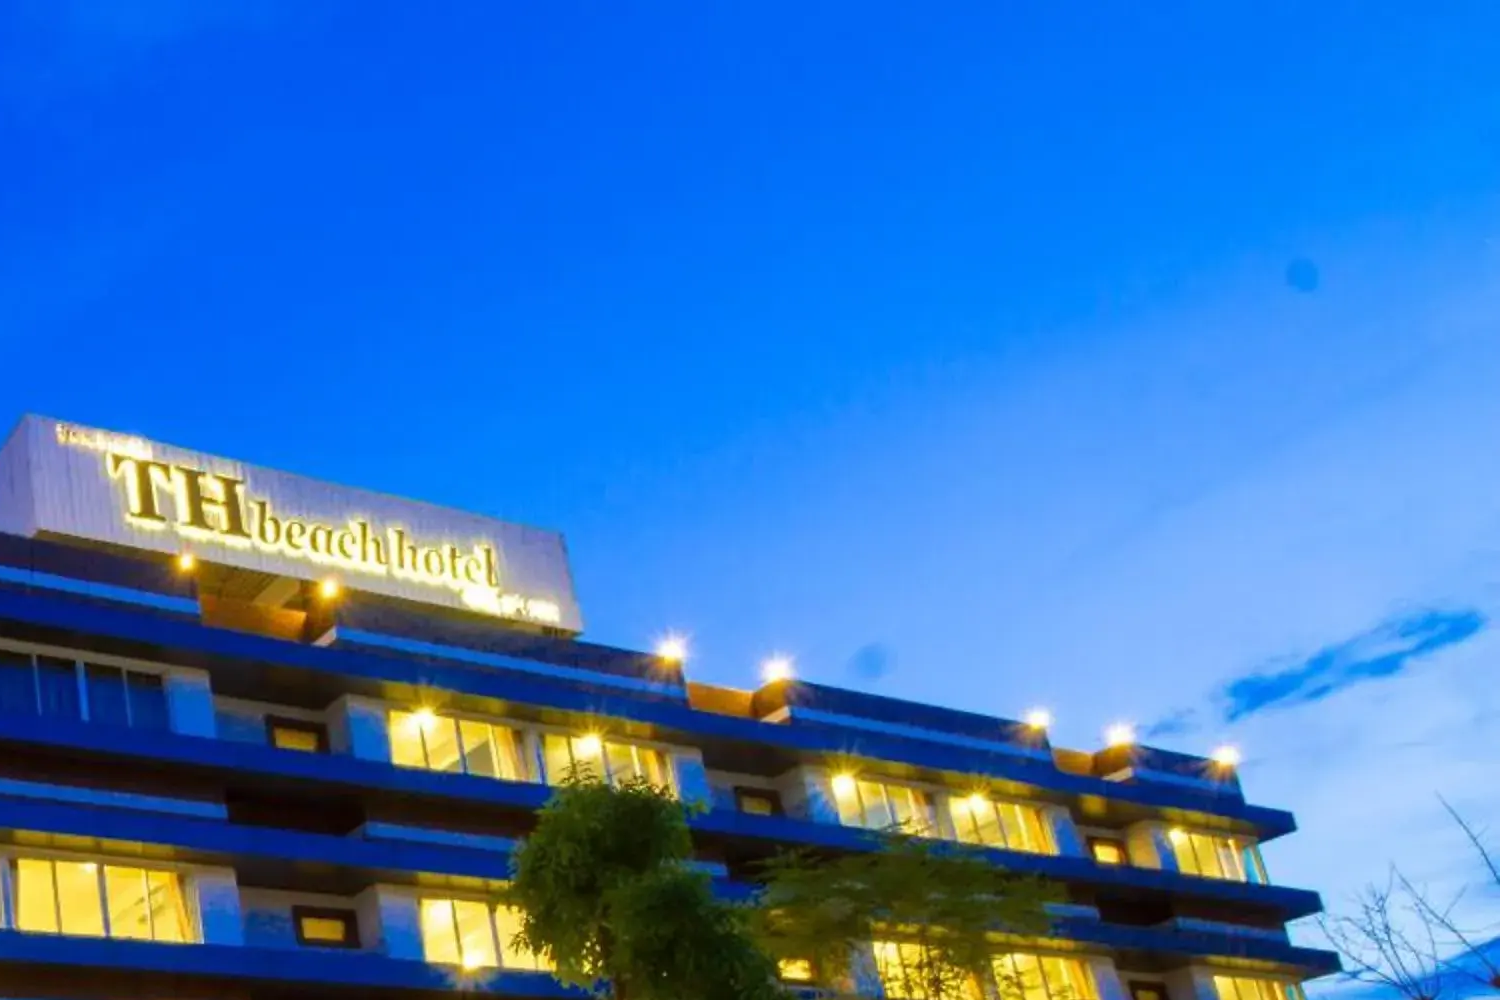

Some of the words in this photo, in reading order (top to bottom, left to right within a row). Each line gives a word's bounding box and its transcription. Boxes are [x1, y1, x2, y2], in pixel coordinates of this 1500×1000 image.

[109, 454, 251, 540] TH
[250, 500, 388, 566] beach
[391, 527, 499, 588] hotel
